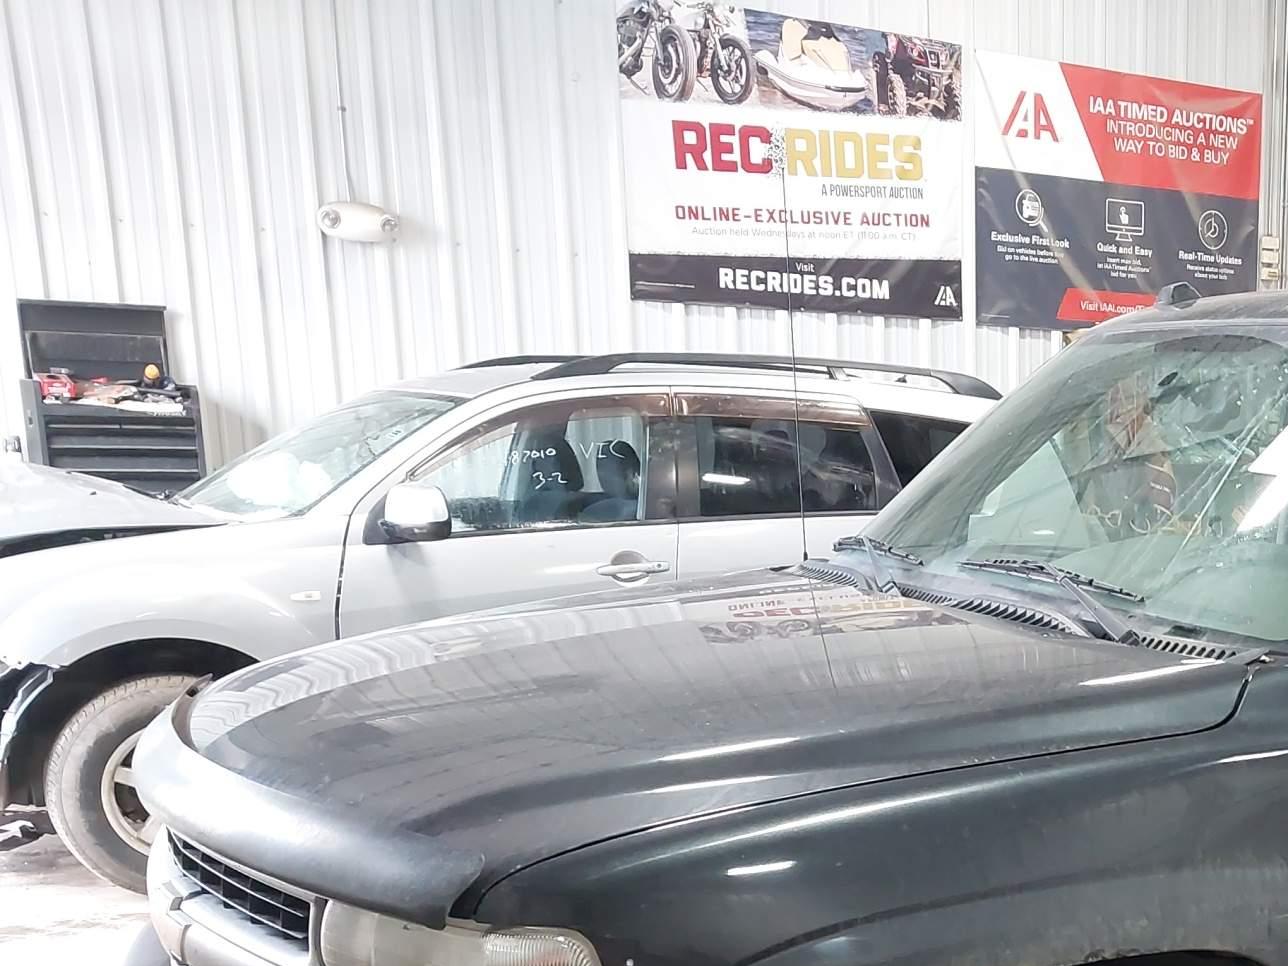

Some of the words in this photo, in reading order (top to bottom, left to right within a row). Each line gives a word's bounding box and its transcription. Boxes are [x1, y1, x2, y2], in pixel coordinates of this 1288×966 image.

[1089, 96, 1115, 116] IAA
[1118, 101, 1168, 123] TIMED
[1106, 119, 1194, 144] INTRODUCING
[1197, 132, 1206, 146] A
[1209, 133, 1238, 149] NEW
[672, 120, 773, 174] REC
[785, 128, 924, 181] RIDES
[1114, 137, 1144, 154] WAY
[1147, 141, 1165, 157] TO
[1168, 144, 1187, 160] BID
[1191, 147, 1200, 161] &
[1203, 149, 1230, 165] BUY
[821, 184, 827, 196] A
[830, 184, 887, 198] POWERSPORT
[889, 187, 923, 200] AUCTION
[675, 205, 853, 225] ONLINE-EXCLUSIVE
[860, 211, 930, 228] AUCTION
[692, 226, 726, 236] Auction
[729, 227, 748, 237] held
[991, 231, 1030, 243] Exclusive
[1031, 235, 1049, 246] First
[1051, 237, 1070, 248] Look
[1097, 241, 1117, 253] Quick
[1118, 245, 1132, 254] and
[1134, 245, 1152, 258] Easy
[1178, 250, 1214, 262] Real-Time
[1216, 253, 1242, 264] Updates
[796, 262, 815, 272] Visit
[718, 268, 889, 300] RECRIDES.COM
[1080, 301, 1098, 311] Visit
